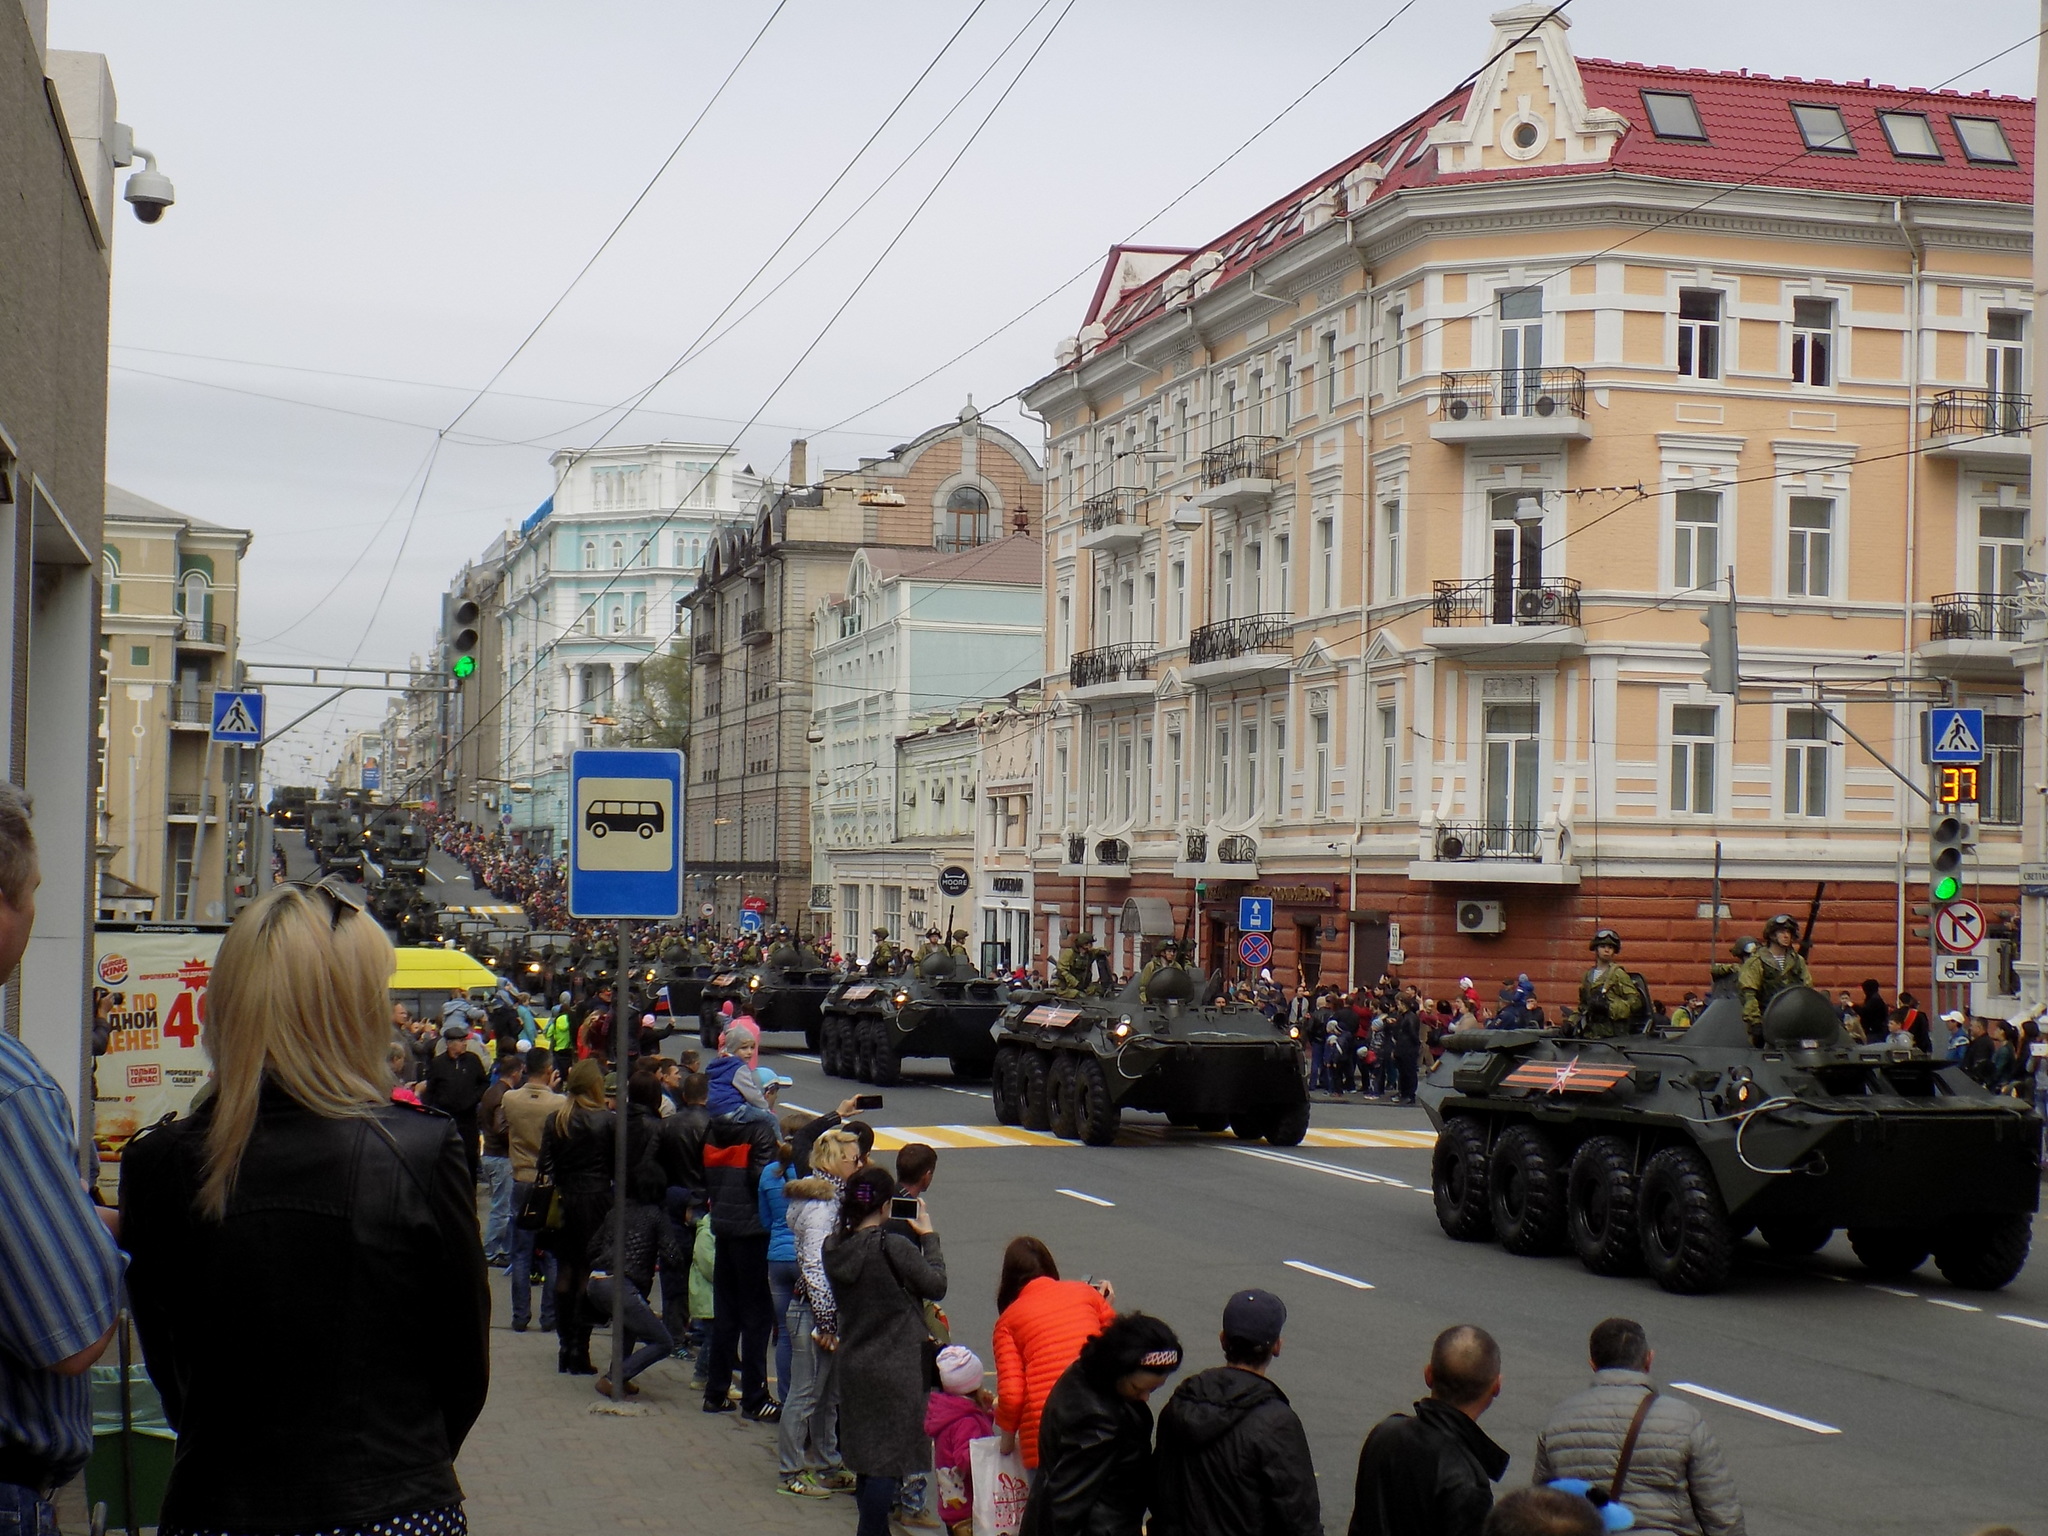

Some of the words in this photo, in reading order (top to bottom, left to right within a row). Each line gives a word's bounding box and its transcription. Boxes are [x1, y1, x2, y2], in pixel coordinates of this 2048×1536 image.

[1943, 768, 1977, 802] 37
[101, 958, 127, 970] BURGER
[102, 964, 128, 977] KING
[132, 992, 157, 1011] ПО
[108, 1012, 158, 1032] ДНОЙ
[130, 1067, 157, 1076] ТОЛЬКО
[165, 1069, 203, 1077] МОРОЖЕНОЕ
[130, 1075, 157, 1084] СЕЙЧАС!
